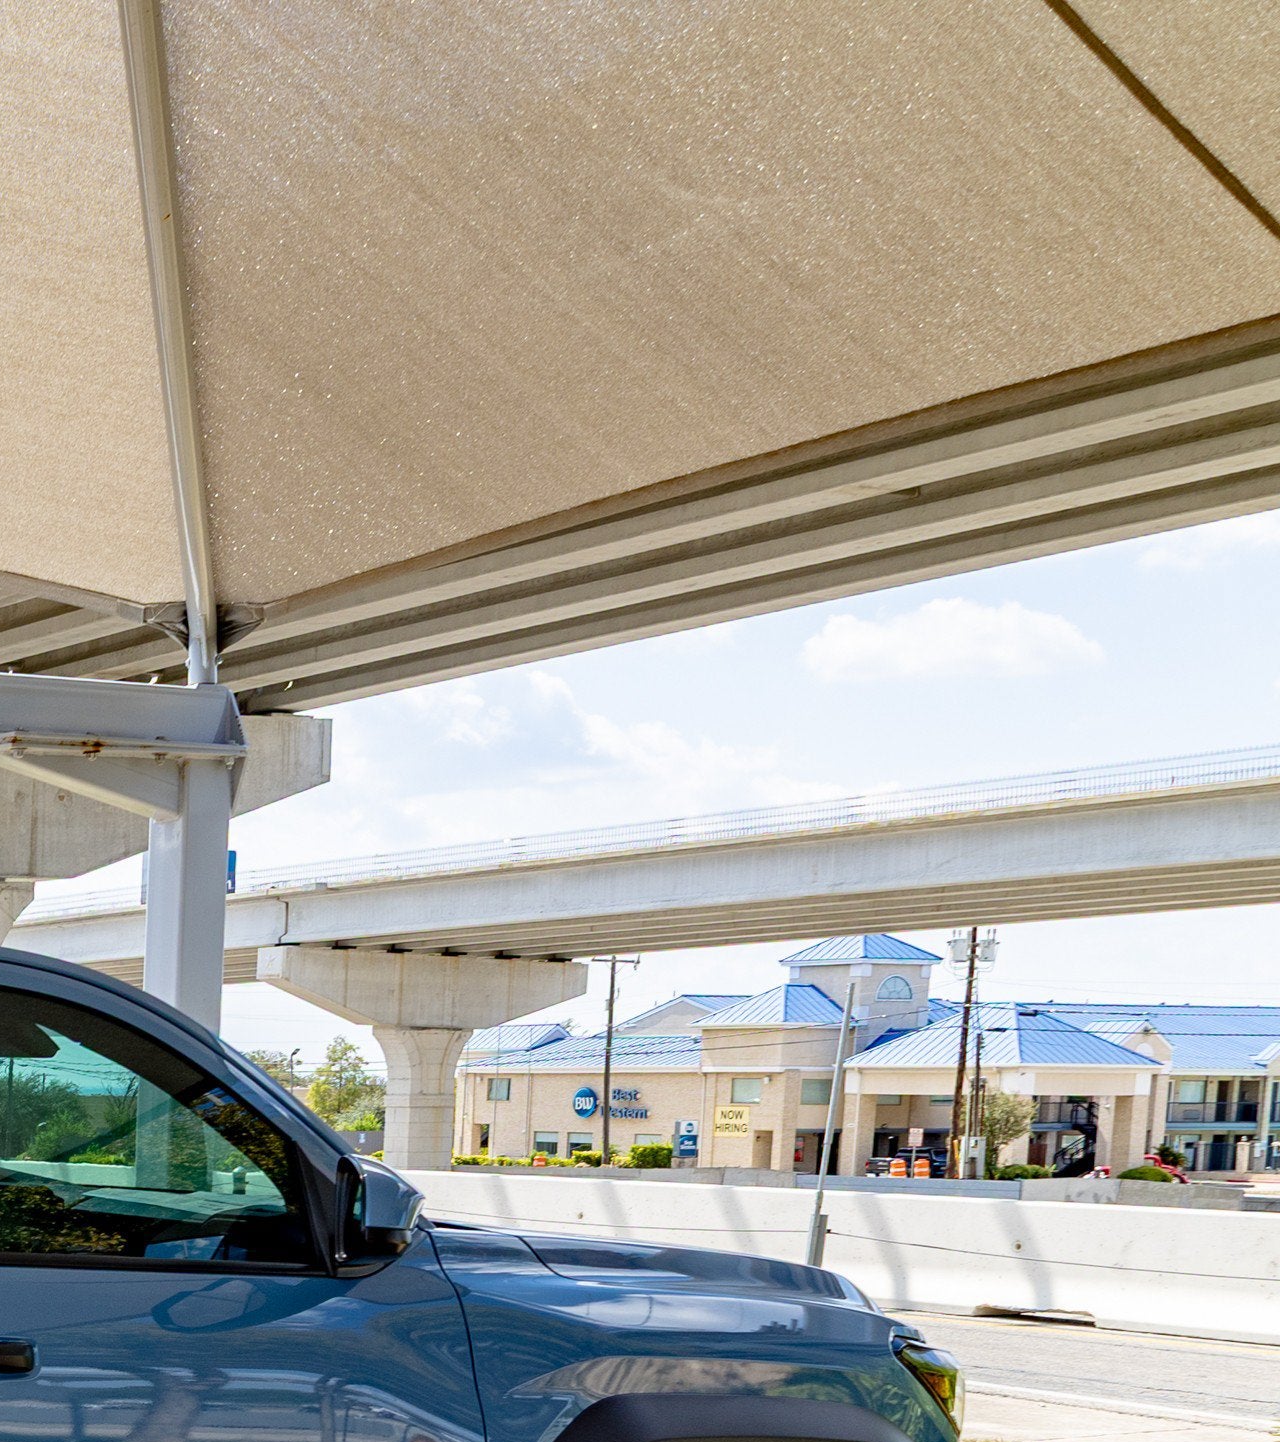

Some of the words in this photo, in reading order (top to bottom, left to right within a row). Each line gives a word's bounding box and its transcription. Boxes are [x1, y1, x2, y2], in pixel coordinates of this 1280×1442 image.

[612, 1088, 640, 1101] Best
[574, 1097, 594, 1110] BW
[720, 1110, 745, 1119] NOW
[715, 1123, 748, 1133] HIRING
